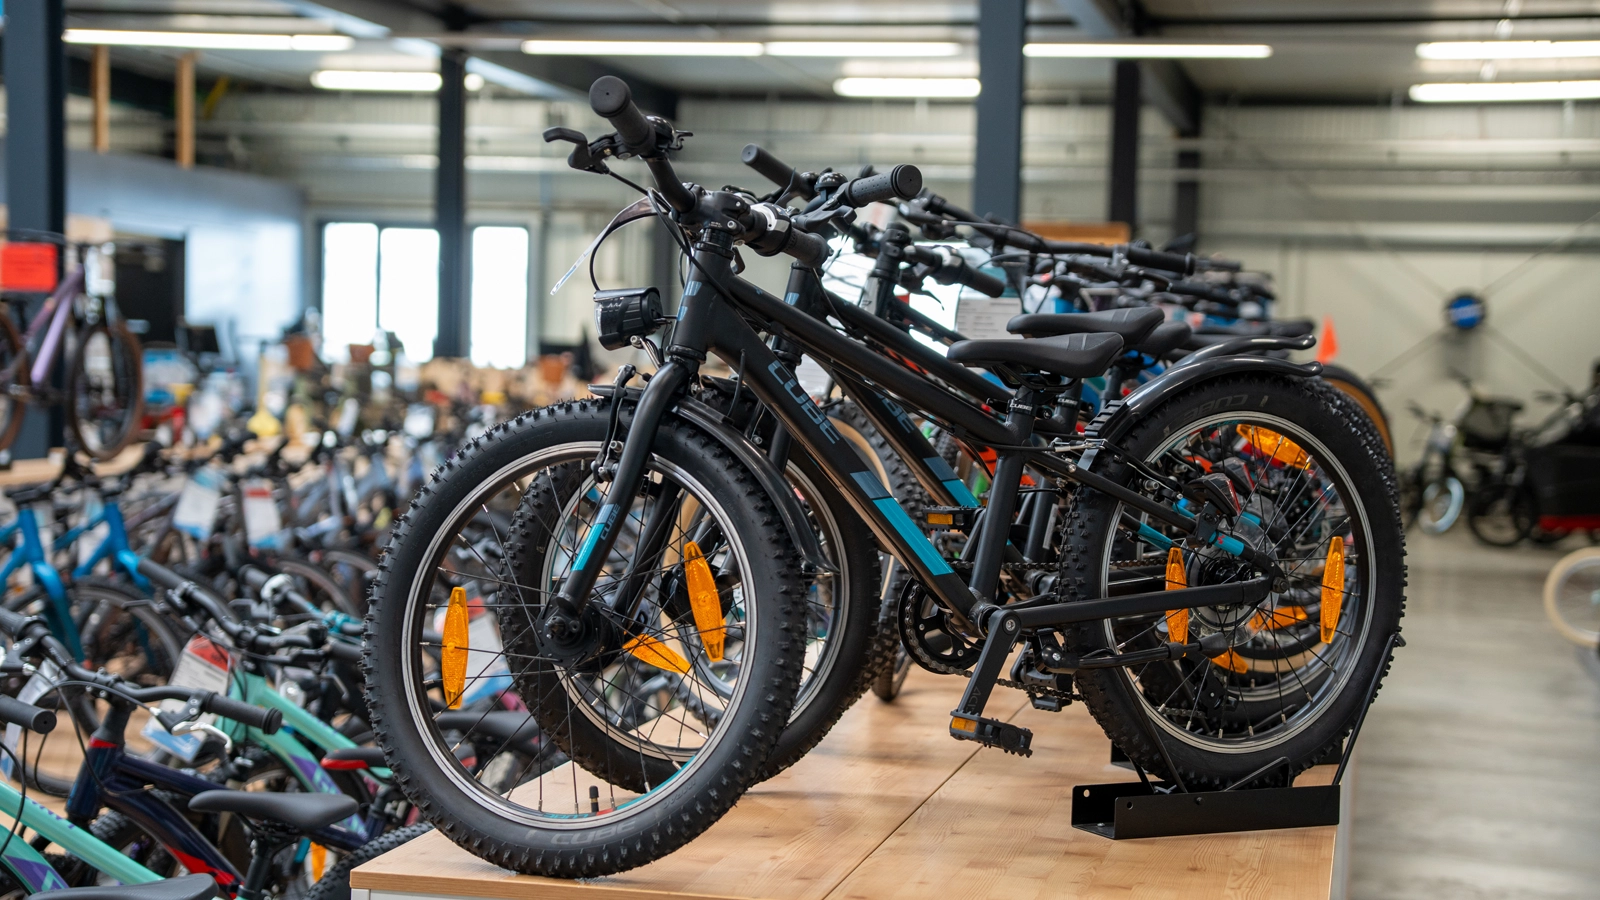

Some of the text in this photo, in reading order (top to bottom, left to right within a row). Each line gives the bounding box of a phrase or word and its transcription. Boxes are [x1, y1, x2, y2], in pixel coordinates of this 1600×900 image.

[767, 359, 843, 445] CUBE
[1009, 402, 1033, 412] CUBE
[1057, 397, 1079, 405] CUBE
[1183, 394, 1249, 420] CUBE
[600, 503, 621, 541] CUBE
[551, 817, 637, 845] CUBE
